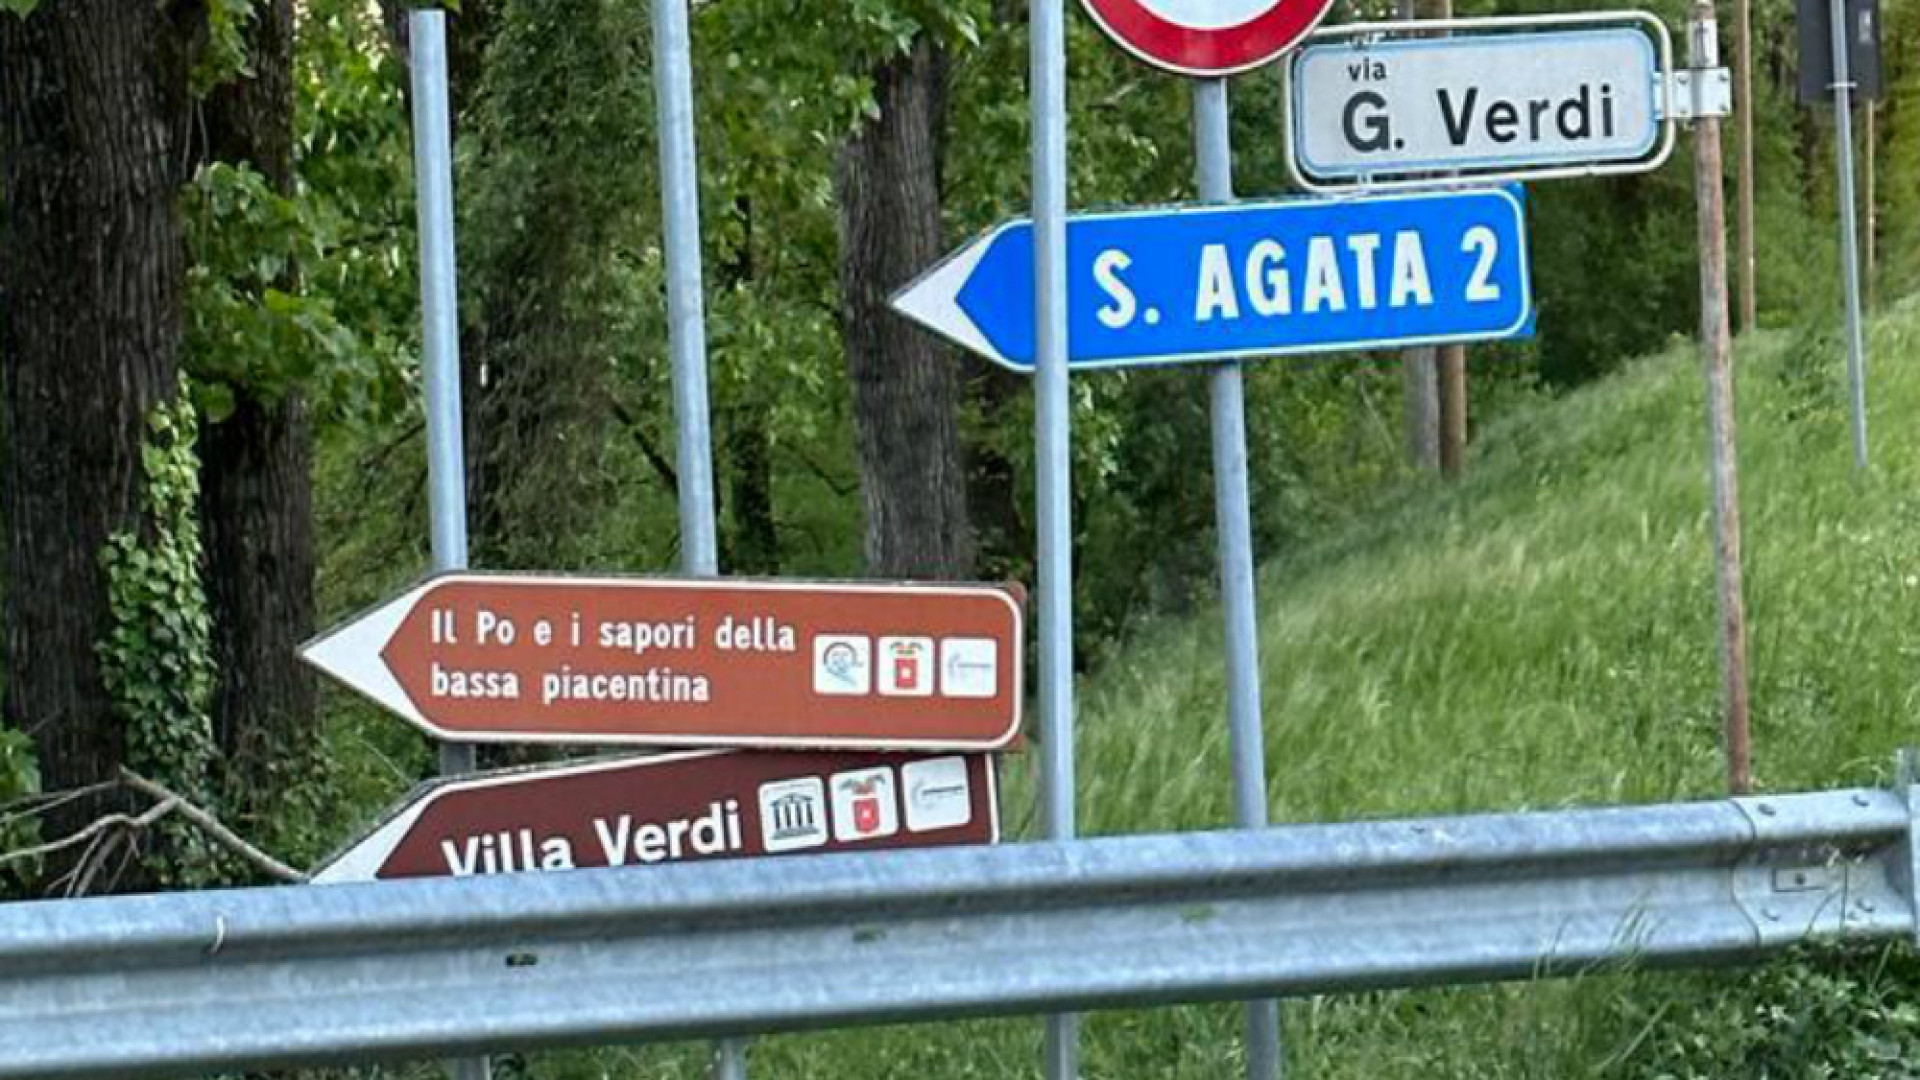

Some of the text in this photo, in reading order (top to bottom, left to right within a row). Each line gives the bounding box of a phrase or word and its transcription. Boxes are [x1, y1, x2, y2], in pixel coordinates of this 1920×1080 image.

[1347, 57, 1387, 81] via
[1342, 84, 1614, 153] G. Verdi
[1092, 225, 1500, 329] S. AGATA 2
[431, 609, 796, 653] Il Po e i sapori della
[431, 662, 710, 705] bassa piacentina
[441, 799, 743, 877] Villa Verdi
